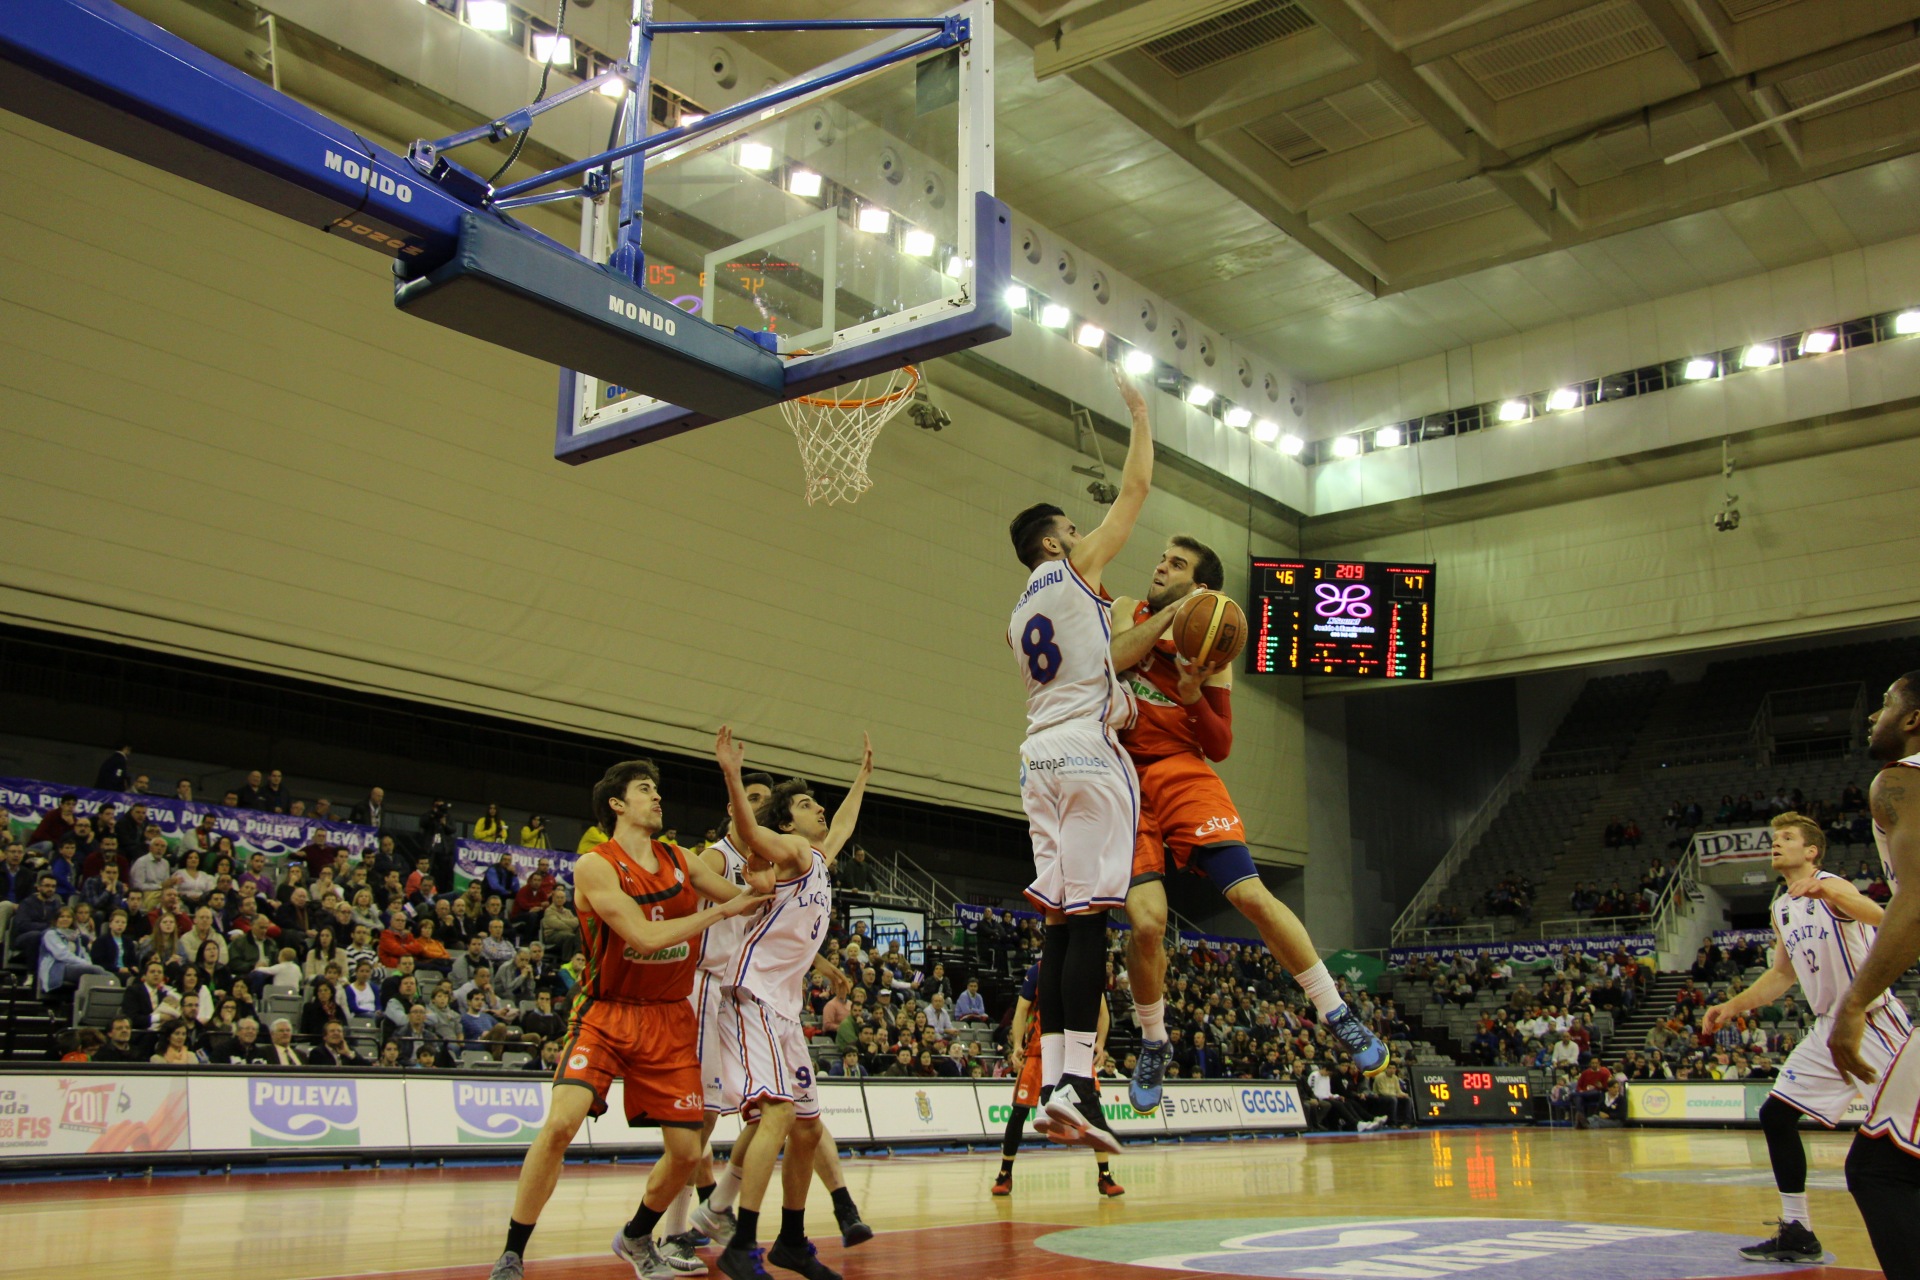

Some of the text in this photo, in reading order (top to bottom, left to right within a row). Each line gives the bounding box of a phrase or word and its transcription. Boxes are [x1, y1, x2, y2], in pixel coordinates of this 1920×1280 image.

[324, 149, 412, 204] MONDO
[608, 294, 676, 337] MONDO
[1276, 570, 1294, 585] 46
[1314, 567, 1321, 579] 3
[1336, 564, 1364, 579] 2:09
[1404, 576, 1423, 589] 47
[1021, 612, 1062, 685] 8
[1206, 816, 1231, 831] stg
[245, 818, 301, 840] PULEVA
[307, 826, 360, 847] PLEVA
[651, 905, 665, 922] 6
[795, 1065, 812, 1089] 9
[1423, 1076, 1446, 1084] LOCAL
[1463, 1073, 1493, 1089] 2:09
[1495, 1075, 1527, 1084] VISITANTE
[254, 1081, 353, 1107] PULEVA
[458, 1083, 540, 1107] PULEVA
[1429, 1083, 1450, 1100] 46
[1508, 1083, 1528, 1099] 47
[1180, 1098, 1233, 1114] DEKTON
[1473, 1095, 1480, 1105] 3
[1686, 1099, 1742, 1108] COVIRAN
[17, 1116, 52, 1139] FIS
